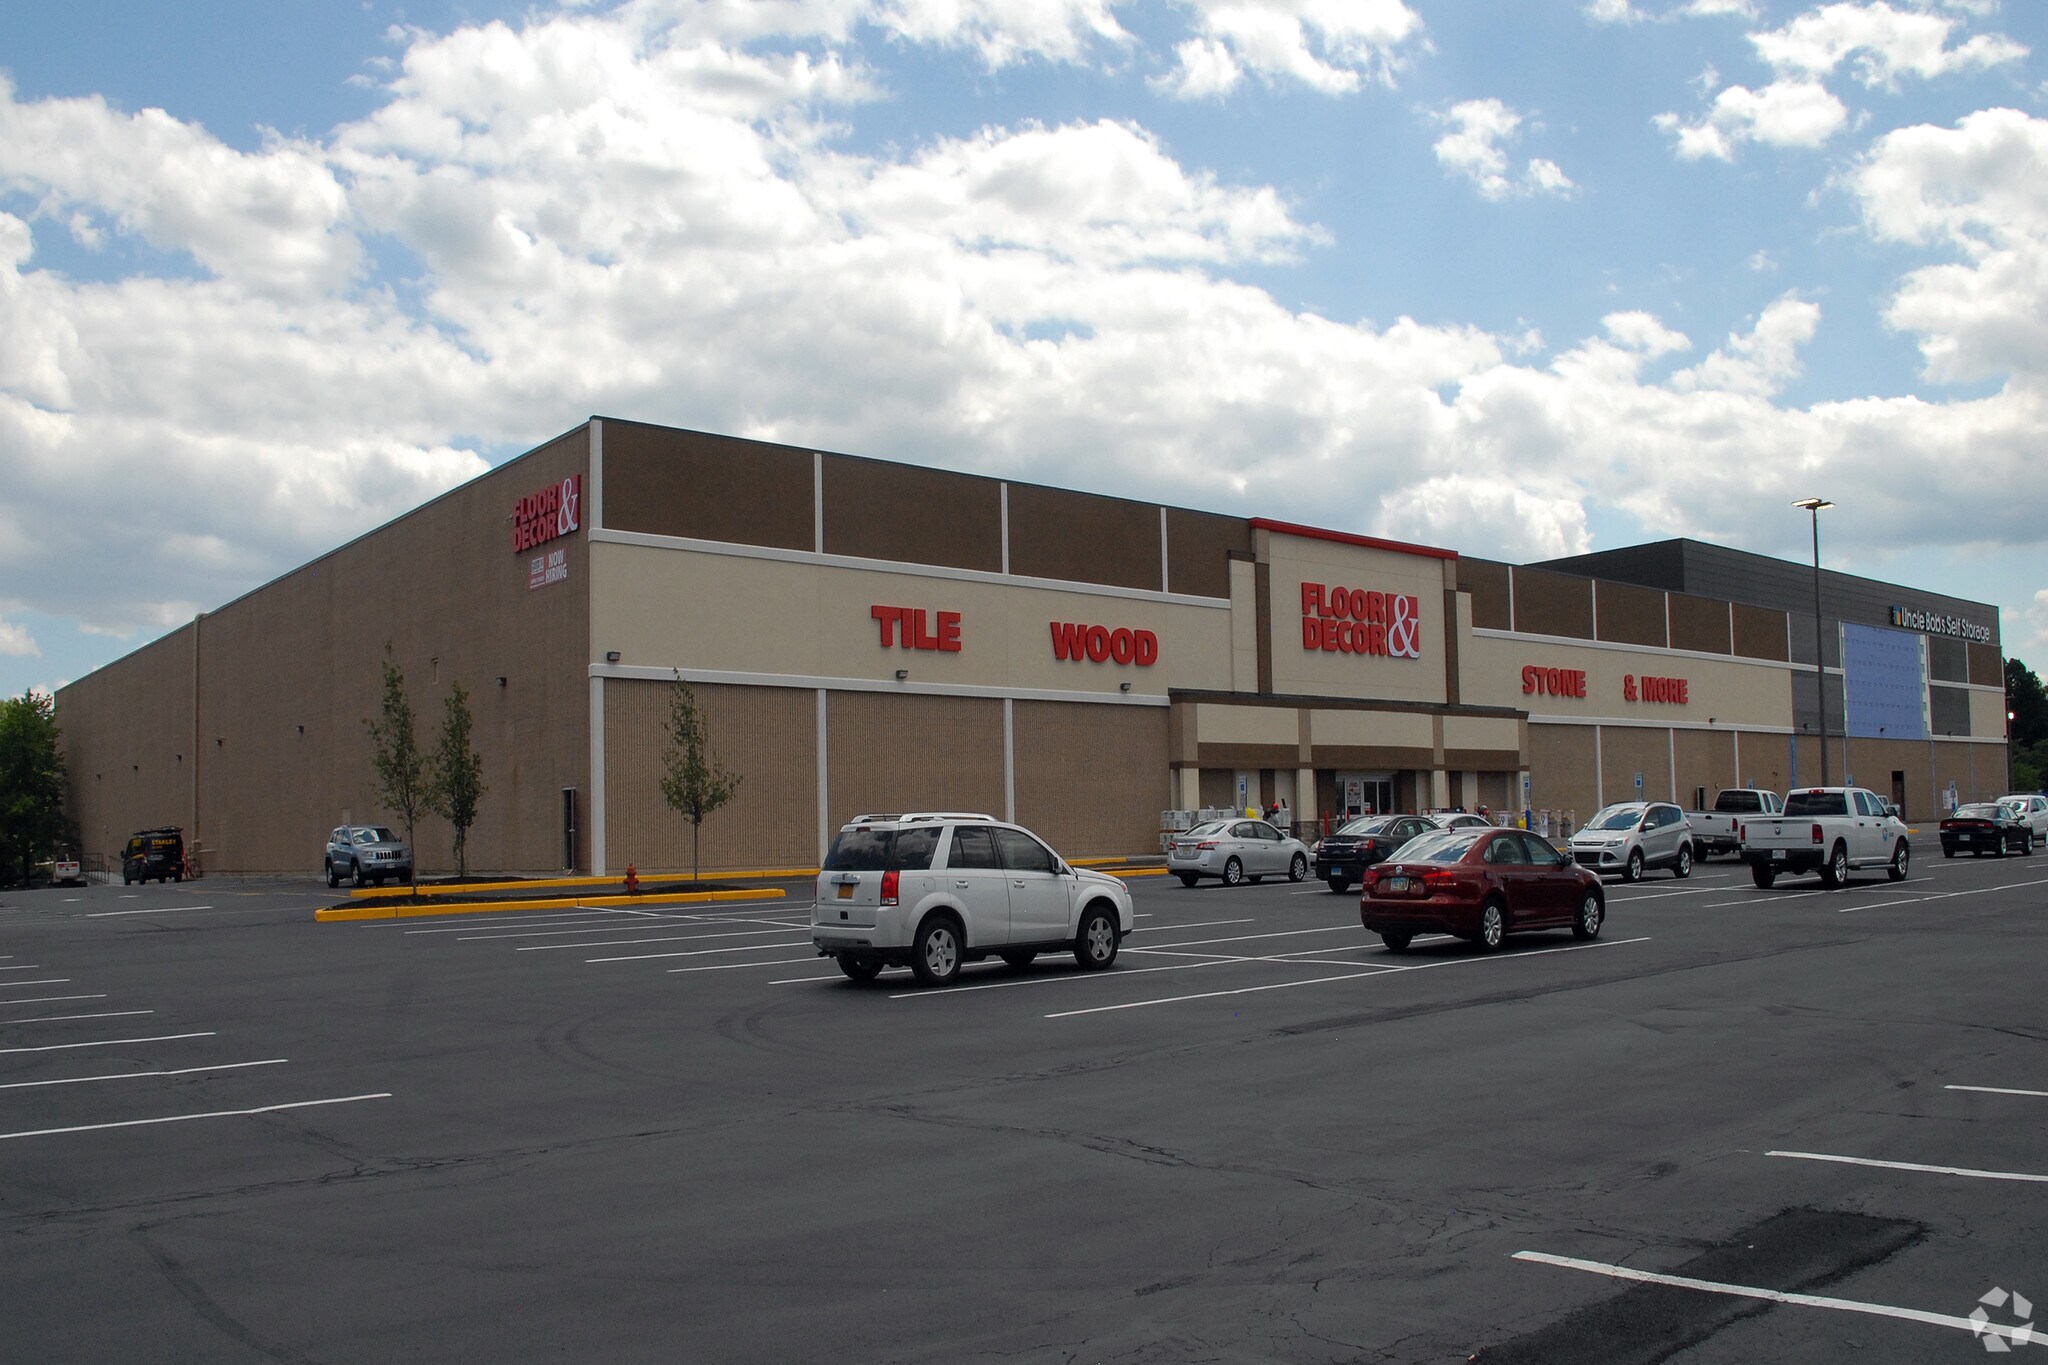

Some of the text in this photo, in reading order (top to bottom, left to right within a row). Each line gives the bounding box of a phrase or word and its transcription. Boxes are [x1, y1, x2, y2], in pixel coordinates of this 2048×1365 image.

[512, 478, 578, 535] FLOOR &
[512, 511, 561, 553] DECOR
[546, 563, 567, 583] HIRING
[549, 549, 564, 568] NOW
[871, 605, 962, 651] TILE
[1301, 582, 1419, 658] FLOOR &
[1302, 617, 1387, 656] DECOR
[1902, 606, 1925, 630] Uncle
[1946, 615, 1961, 636] Self
[1961, 618, 1990, 643] Storage
[1050, 622, 1158, 666] WOOD
[1522, 665, 1586, 698] STONE
[1624, 674, 1689, 705] & MORE
